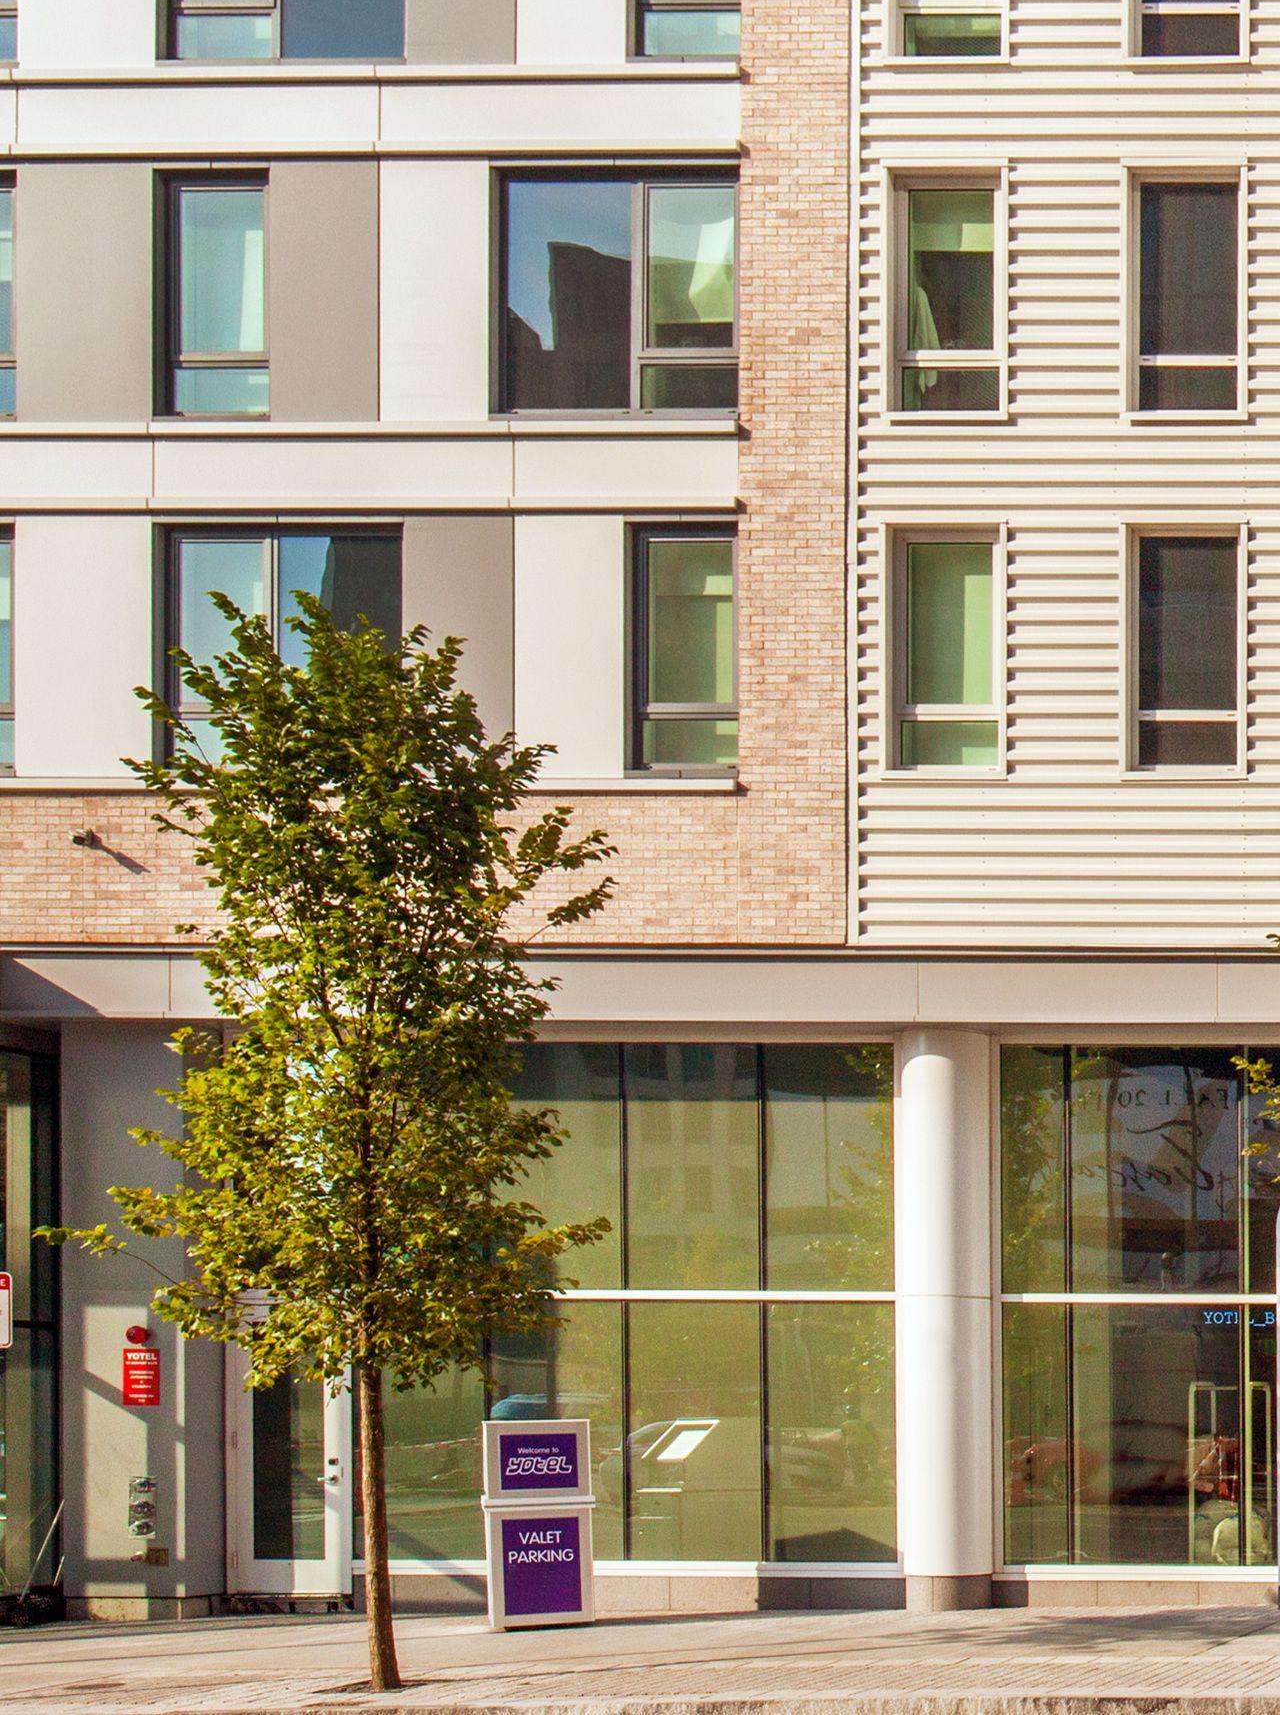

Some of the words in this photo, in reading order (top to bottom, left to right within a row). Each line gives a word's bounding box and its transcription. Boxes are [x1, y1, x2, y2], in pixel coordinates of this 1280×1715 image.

[126, 1352, 158, 1361] YOTEL
[517, 1446, 550, 1455] Welcome
[551, 1446, 560, 1454] to
[518, 1530, 562, 1545] VALET
[508, 1548, 575, 1564] PARKING
